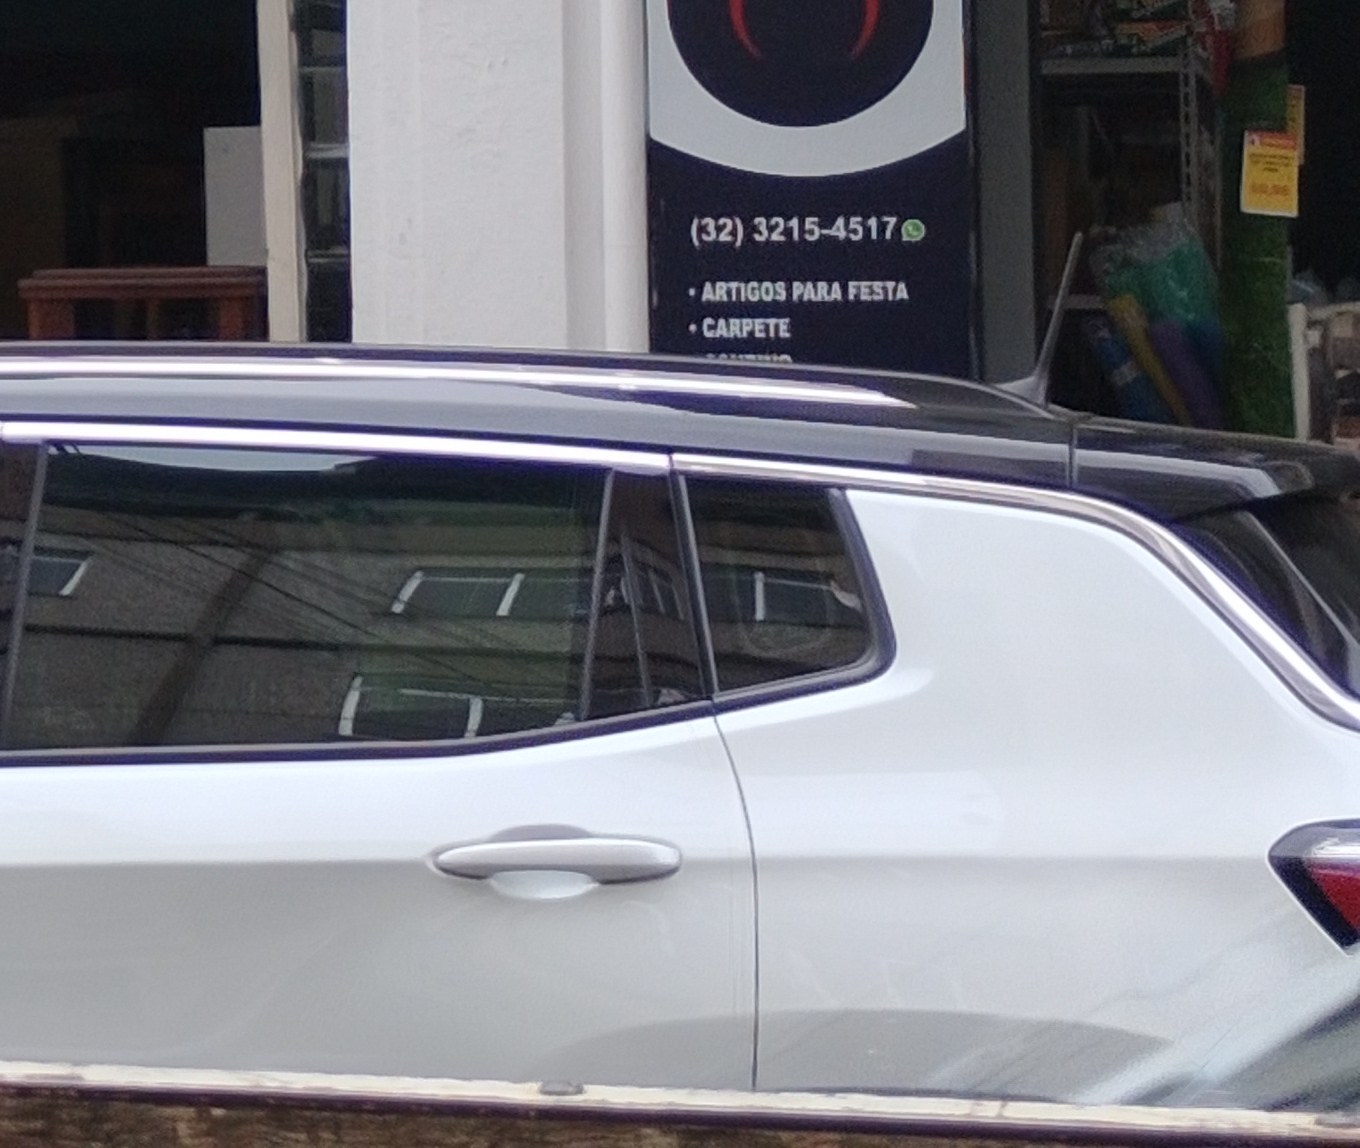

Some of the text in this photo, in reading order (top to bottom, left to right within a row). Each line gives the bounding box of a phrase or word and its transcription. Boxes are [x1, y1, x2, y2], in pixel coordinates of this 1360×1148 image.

[690, 215, 897, 247] (32) 3215-4517
[701, 281, 909, 302] ARTIGOS PARA FESTA
[702, 318, 791, 338] CARPETE
